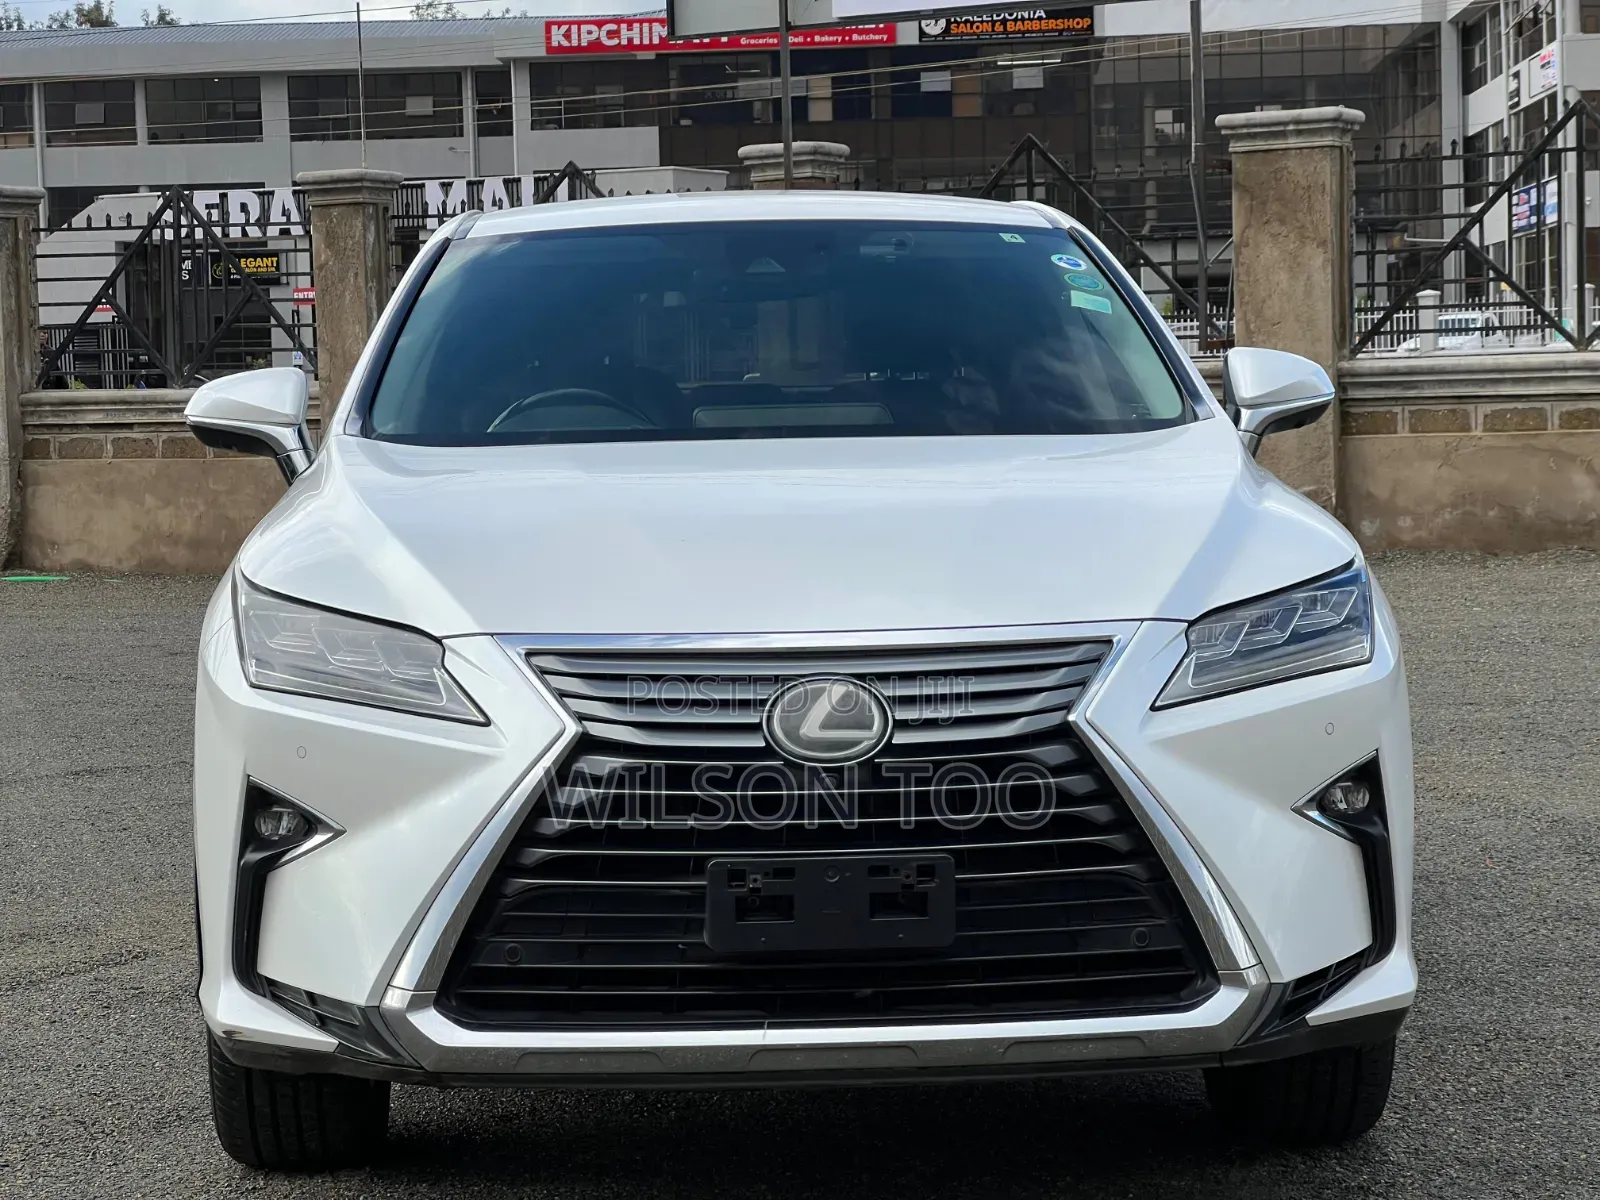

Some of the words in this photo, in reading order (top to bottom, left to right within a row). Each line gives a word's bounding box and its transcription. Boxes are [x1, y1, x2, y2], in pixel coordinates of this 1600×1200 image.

[950, 22, 992, 34] SALON
[994, 21, 1004, 32] &
[1007, 17, 1092, 32] BARBERSHOP
[740, 37, 778, 45] Groceries
[788, 35, 804, 43] Deli
[814, 34, 842, 43] Bakery
[852, 33, 888, 42] Butchery
[229, 257, 278, 268] EGANT
